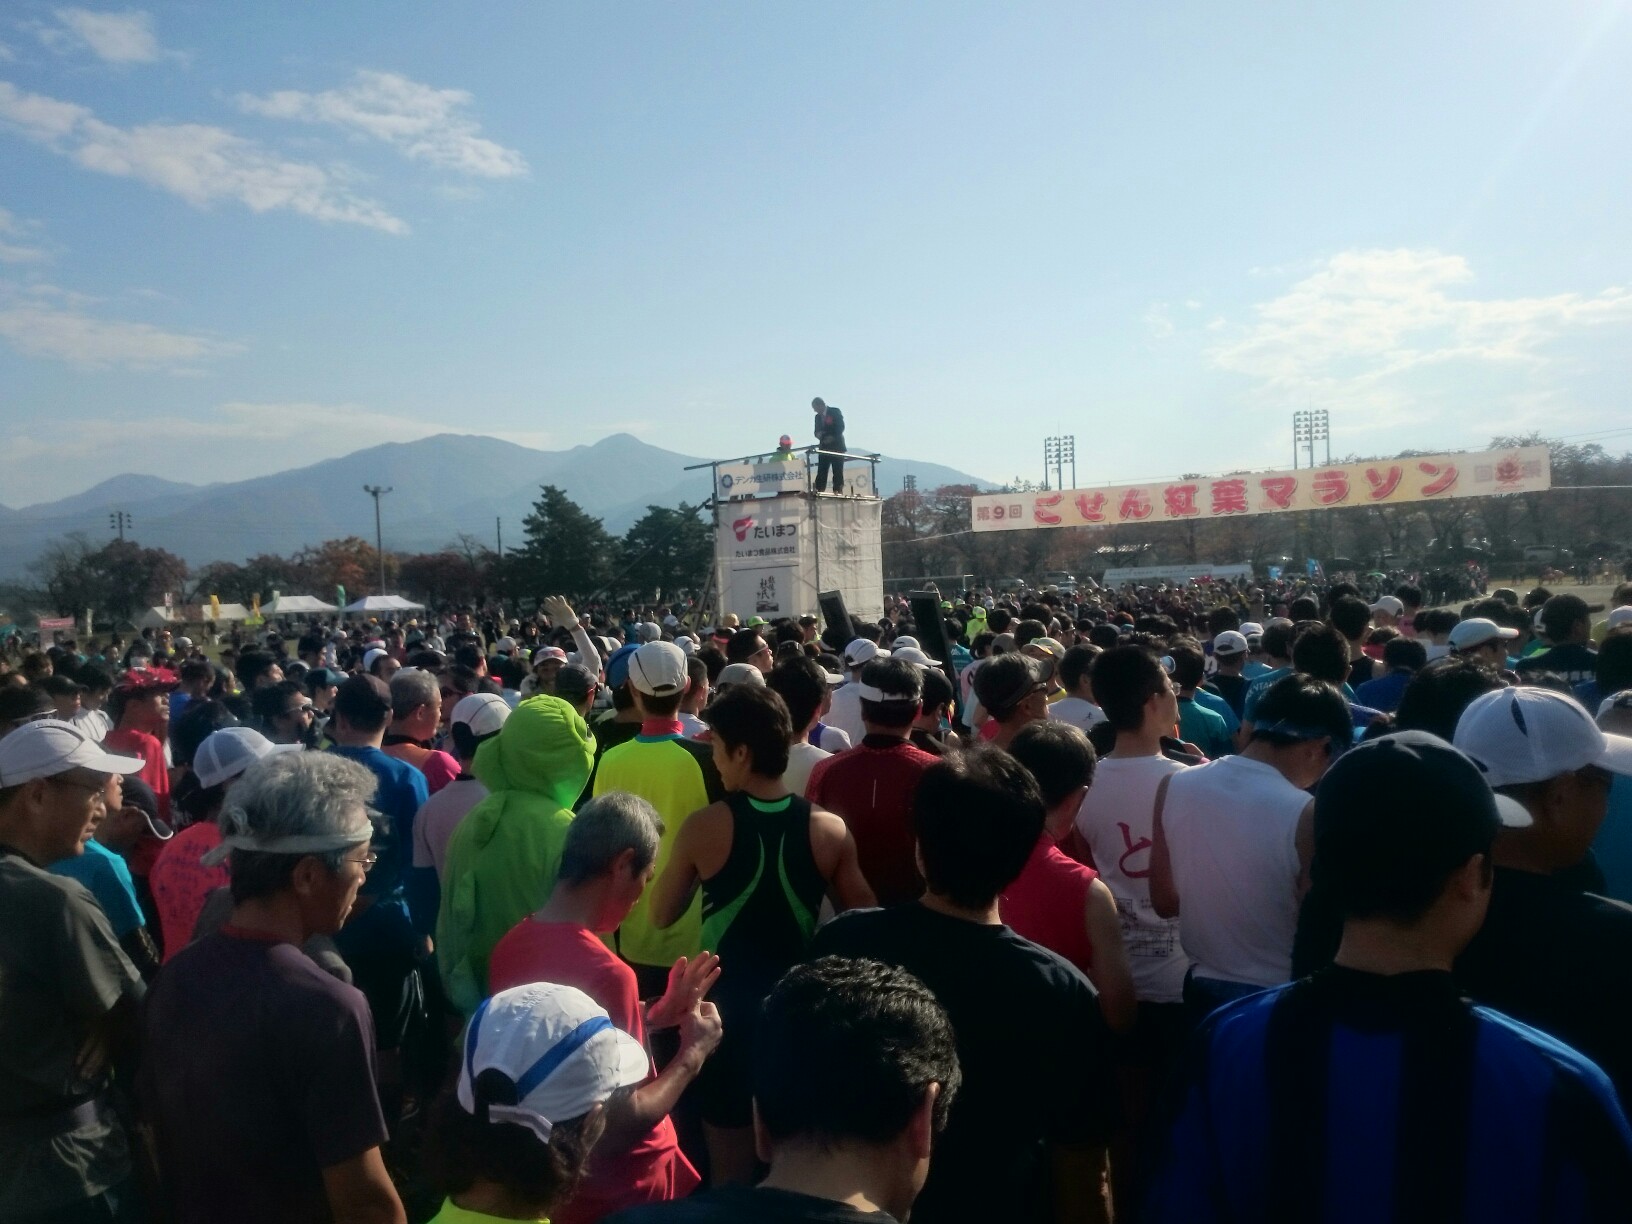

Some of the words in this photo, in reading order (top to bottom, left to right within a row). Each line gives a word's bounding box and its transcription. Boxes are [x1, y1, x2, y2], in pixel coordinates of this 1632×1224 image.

[735, 471, 803, 485] デンカ生研株式会社
[976, 503, 1022, 521] 第9回
[1033, 462, 1459, 525] ごせん紅葉マラソン
[754, 524, 796, 538] たいまつ
[736, 546, 795, 557] たいまつ食品株式会社
